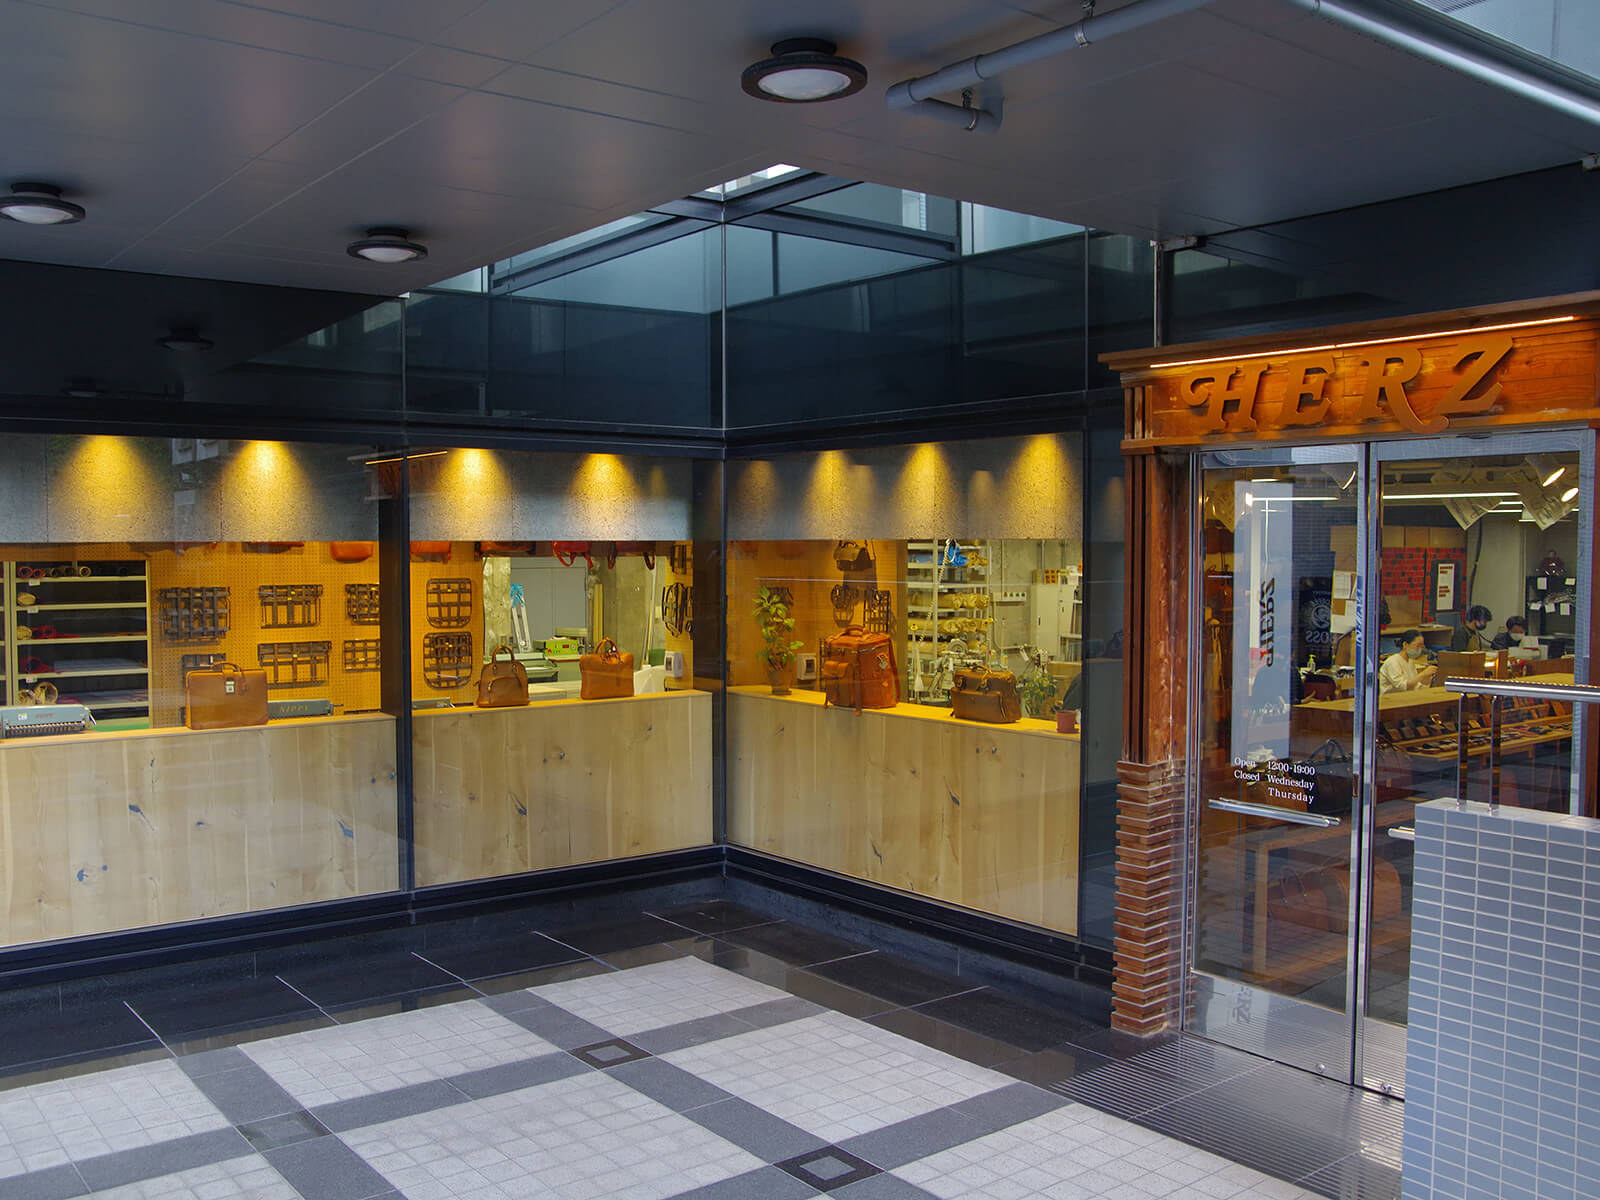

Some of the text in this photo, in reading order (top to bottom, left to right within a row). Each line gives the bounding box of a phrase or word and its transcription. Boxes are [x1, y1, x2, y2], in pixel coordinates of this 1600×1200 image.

[1181, 335, 1513, 434] HERZ
[1234, 756, 1256, 768] Open
[1234, 769, 1315, 790] Closed Wednesday
[1268, 787, 1314, 804] Thursday
